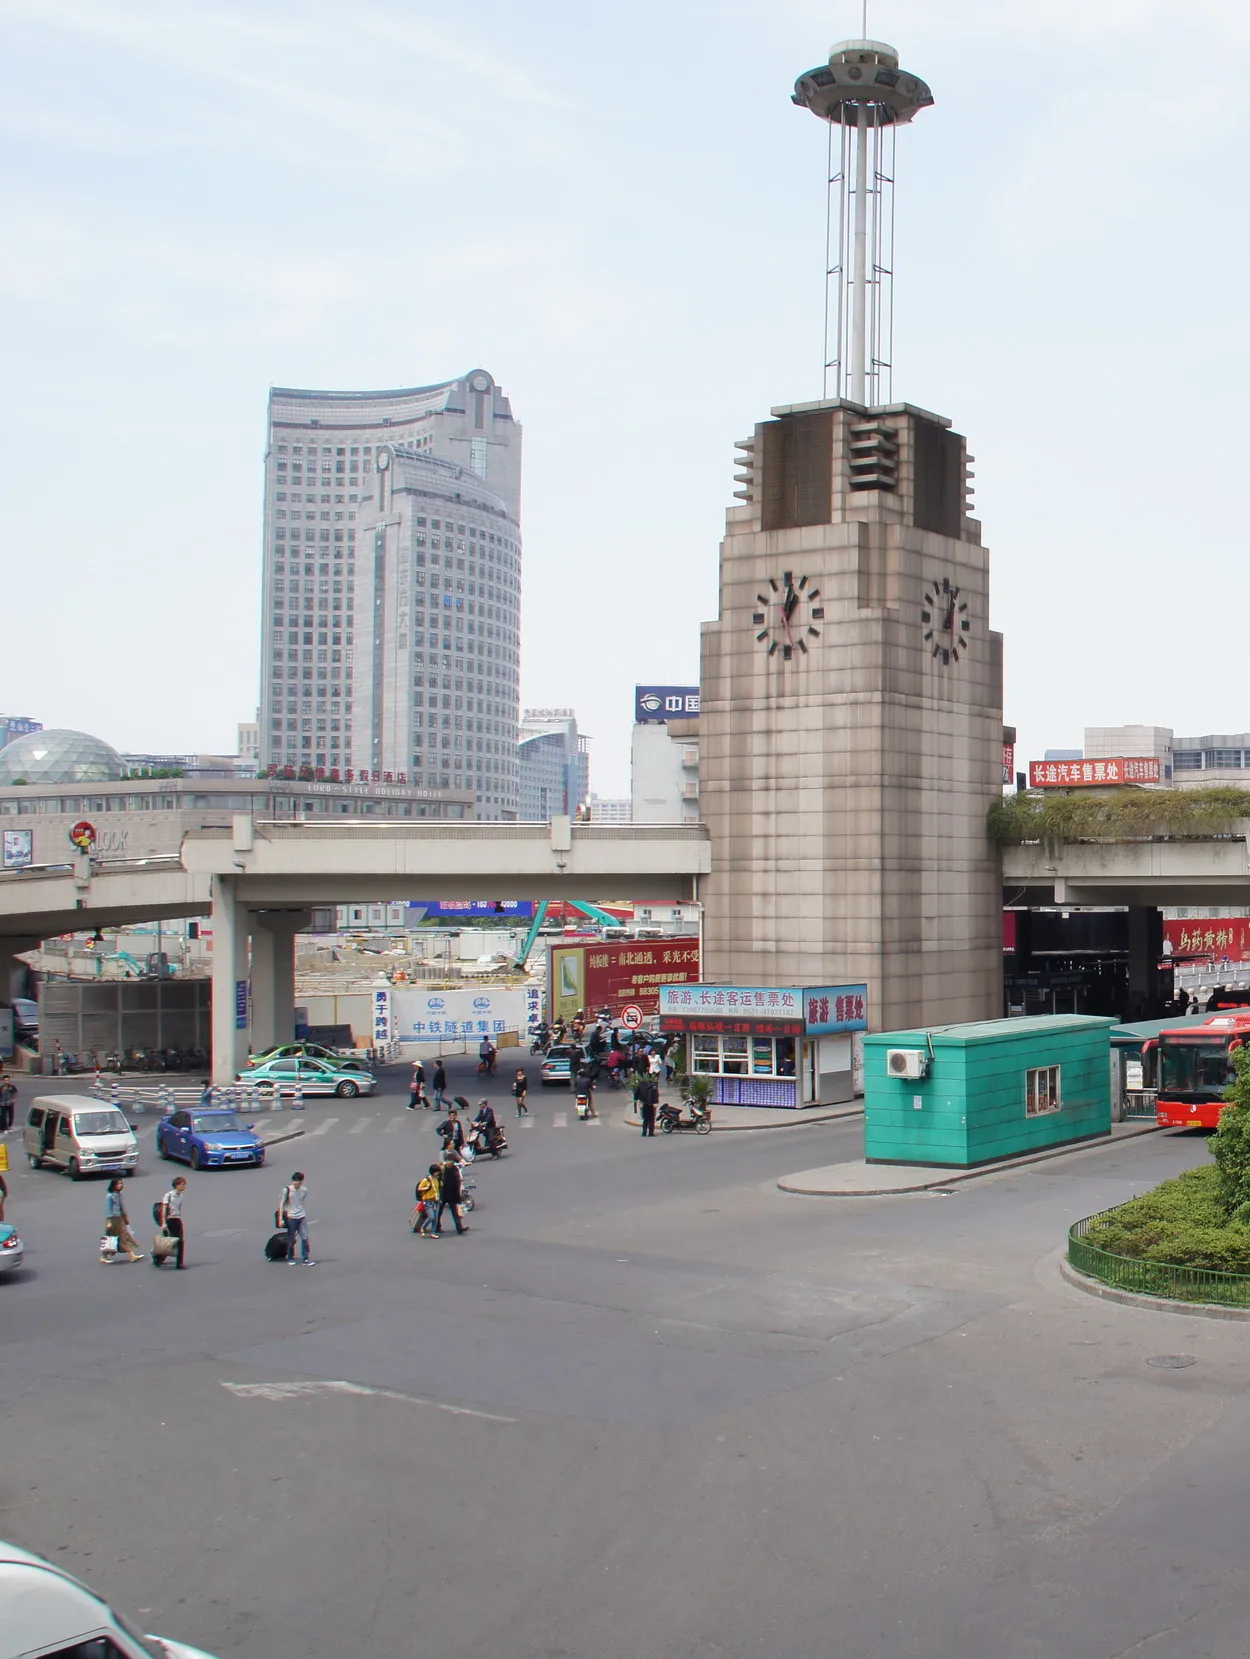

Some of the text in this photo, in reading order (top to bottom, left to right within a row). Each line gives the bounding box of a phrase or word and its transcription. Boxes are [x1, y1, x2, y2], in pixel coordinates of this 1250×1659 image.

[665, 695, 700, 712] 中国
[1034, 762, 1118, 783] 长途汽车售票处
[1124, 760, 1159, 780] 长途汽车售票处
[375, 991, 389, 1041] 勇于跨越
[808, 994, 864, 1025] 旅游 售票处
[413, 1020, 506, 1034] 中铁隧道集团
